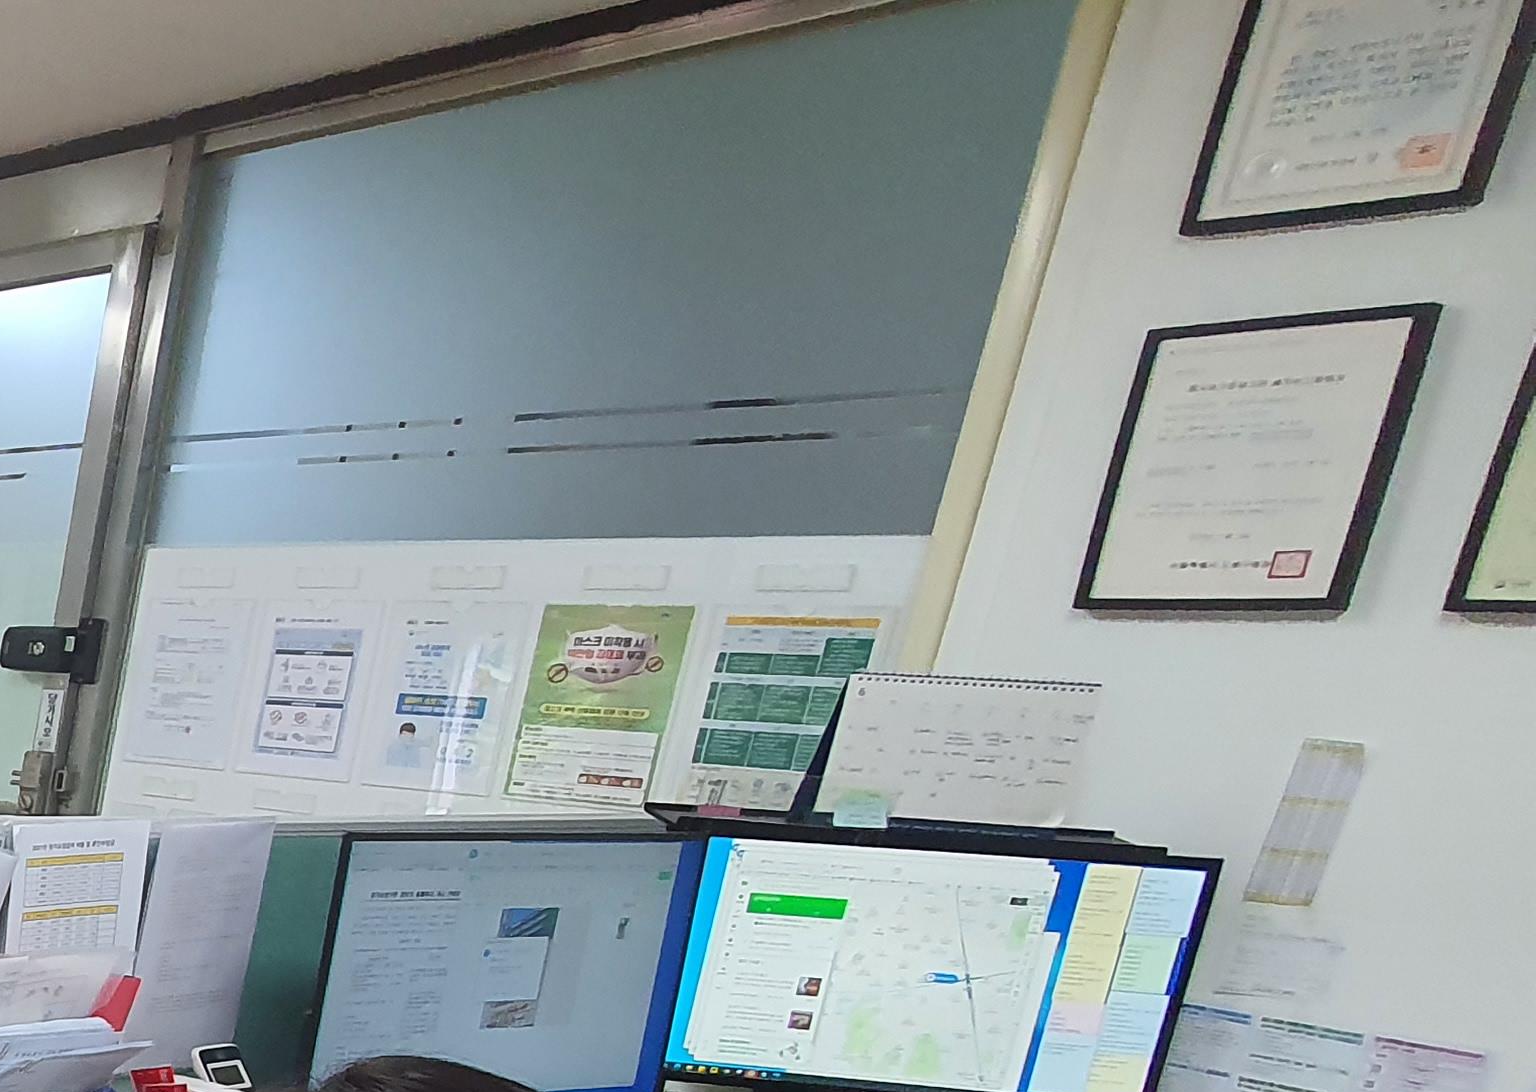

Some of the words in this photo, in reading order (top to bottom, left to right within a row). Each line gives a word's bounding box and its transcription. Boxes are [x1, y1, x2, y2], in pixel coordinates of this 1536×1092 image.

[574, 636, 601, 647] 마스크
[604, 636, 633, 648] 미착용
[634, 637, 646, 648] 시
[858, 687, 866, 697] 6
